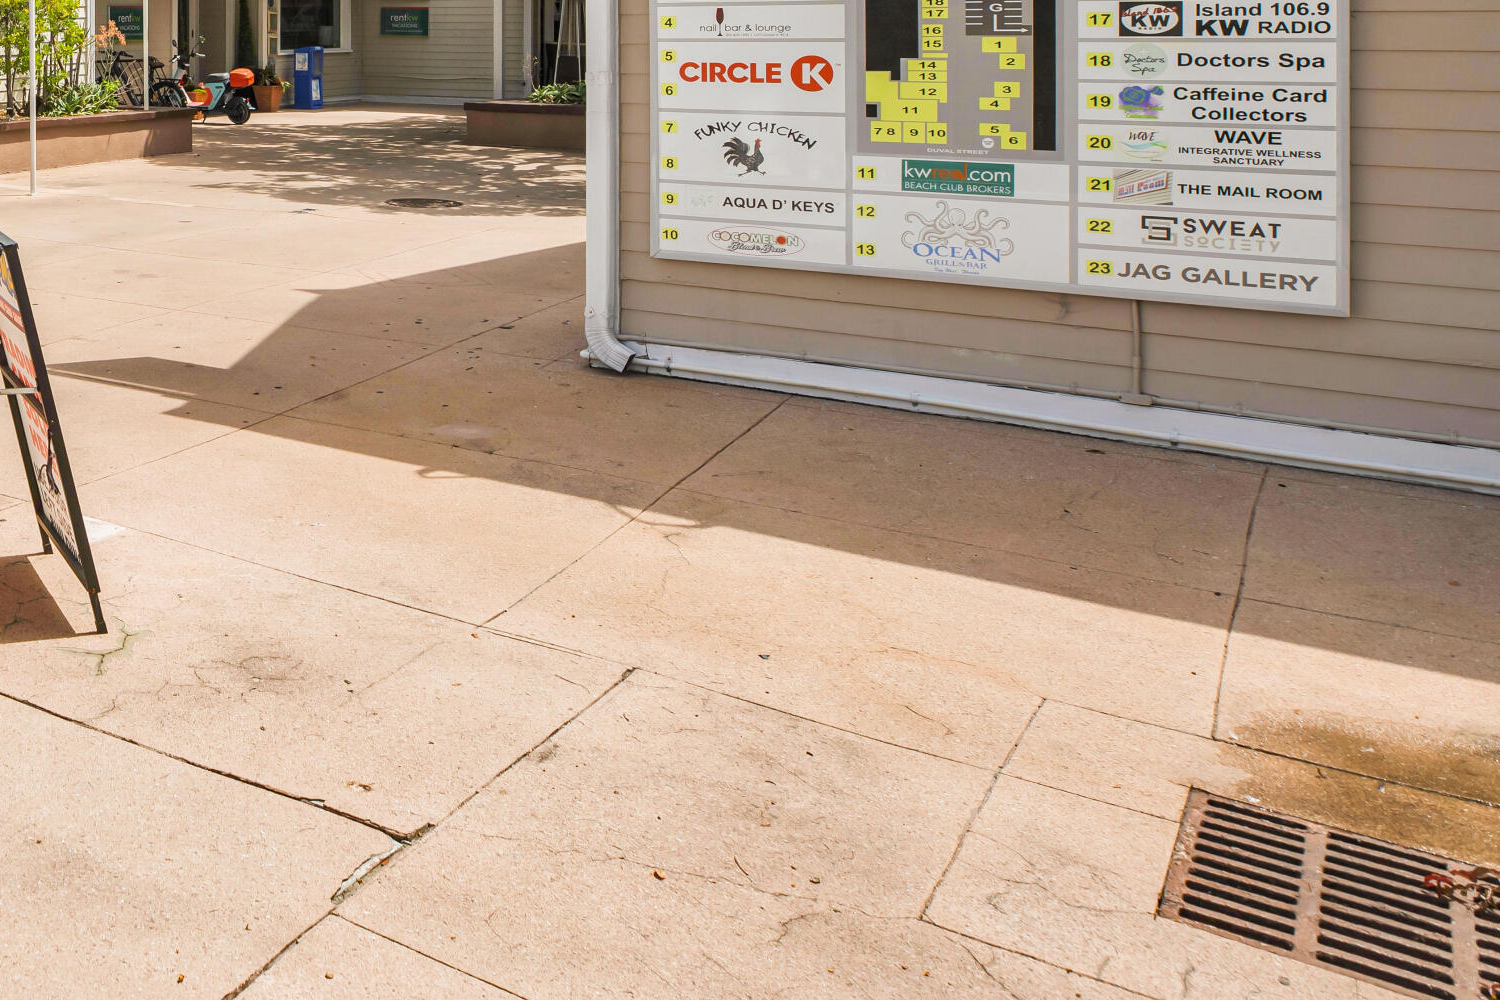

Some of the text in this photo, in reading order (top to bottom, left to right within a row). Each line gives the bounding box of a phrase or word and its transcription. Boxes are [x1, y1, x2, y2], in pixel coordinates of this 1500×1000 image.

[1196, 3, 1329, 16] Island 106.9
[664, 18, 673, 27] 4
[1090, 14, 1111, 25] 17
[1131, 15, 1170, 27] KW
[700, 24, 717, 32] nail
[724, 24, 742, 32] bar
[755, 24, 792, 34] lounge
[1195, 20, 1331, 36] KW RADIO
[924, 40, 941, 48] 15
[993, 41, 1001, 49] 1
[665, 51, 673, 61] 5
[1090, 56, 1111, 66] 18
[1177, 53, 1325, 71] Doctors Spa
[679, 60, 833, 92] CIRCLE K
[665, 86, 673, 95] 6
[919, 88, 937, 96] 12
[1173, 87, 1327, 103] Caffeine Card
[1090, 96, 1111, 107] 19
[1192, 107, 1307, 122] Collectors
[666, 123, 674, 132] 7
[694, 121, 817, 150] FUNKY CHICKEN
[1214, 130, 1282, 145] WAVE
[1090, 138, 1111, 148] 20
[1179, 147, 1321, 159] INTEGRATIVE WELLNESS
[666, 159, 674, 169] 8
[1213, 156, 1284, 167] SANCTUARY
[858, 168, 874, 179] 11
[904, 160, 1011, 182] kwreal.com
[904, 181, 1011, 195] BEACH CLUB BROKERS
[1090, 179, 1111, 190] 21
[1178, 184, 1322, 200] THE MAIL ROOM
[666, 194, 674, 204] 9
[723, 197, 768, 209] AQUA
[791, 201, 835, 213] KEYS
[857, 207, 875, 217] 12
[1090, 221, 1111, 232] 22
[1183, 218, 1281, 238] SWEAT
[663, 230, 678, 240] 10
[712, 231, 798, 247] COCOMELON
[1185, 236, 1279, 252] SOCIETY
[857, 245, 875, 255] 13
[913, 243, 1000, 263] OCEAN
[1090, 263, 1111, 274] 23
[1117, 262, 1319, 292] JAG GALLERY
